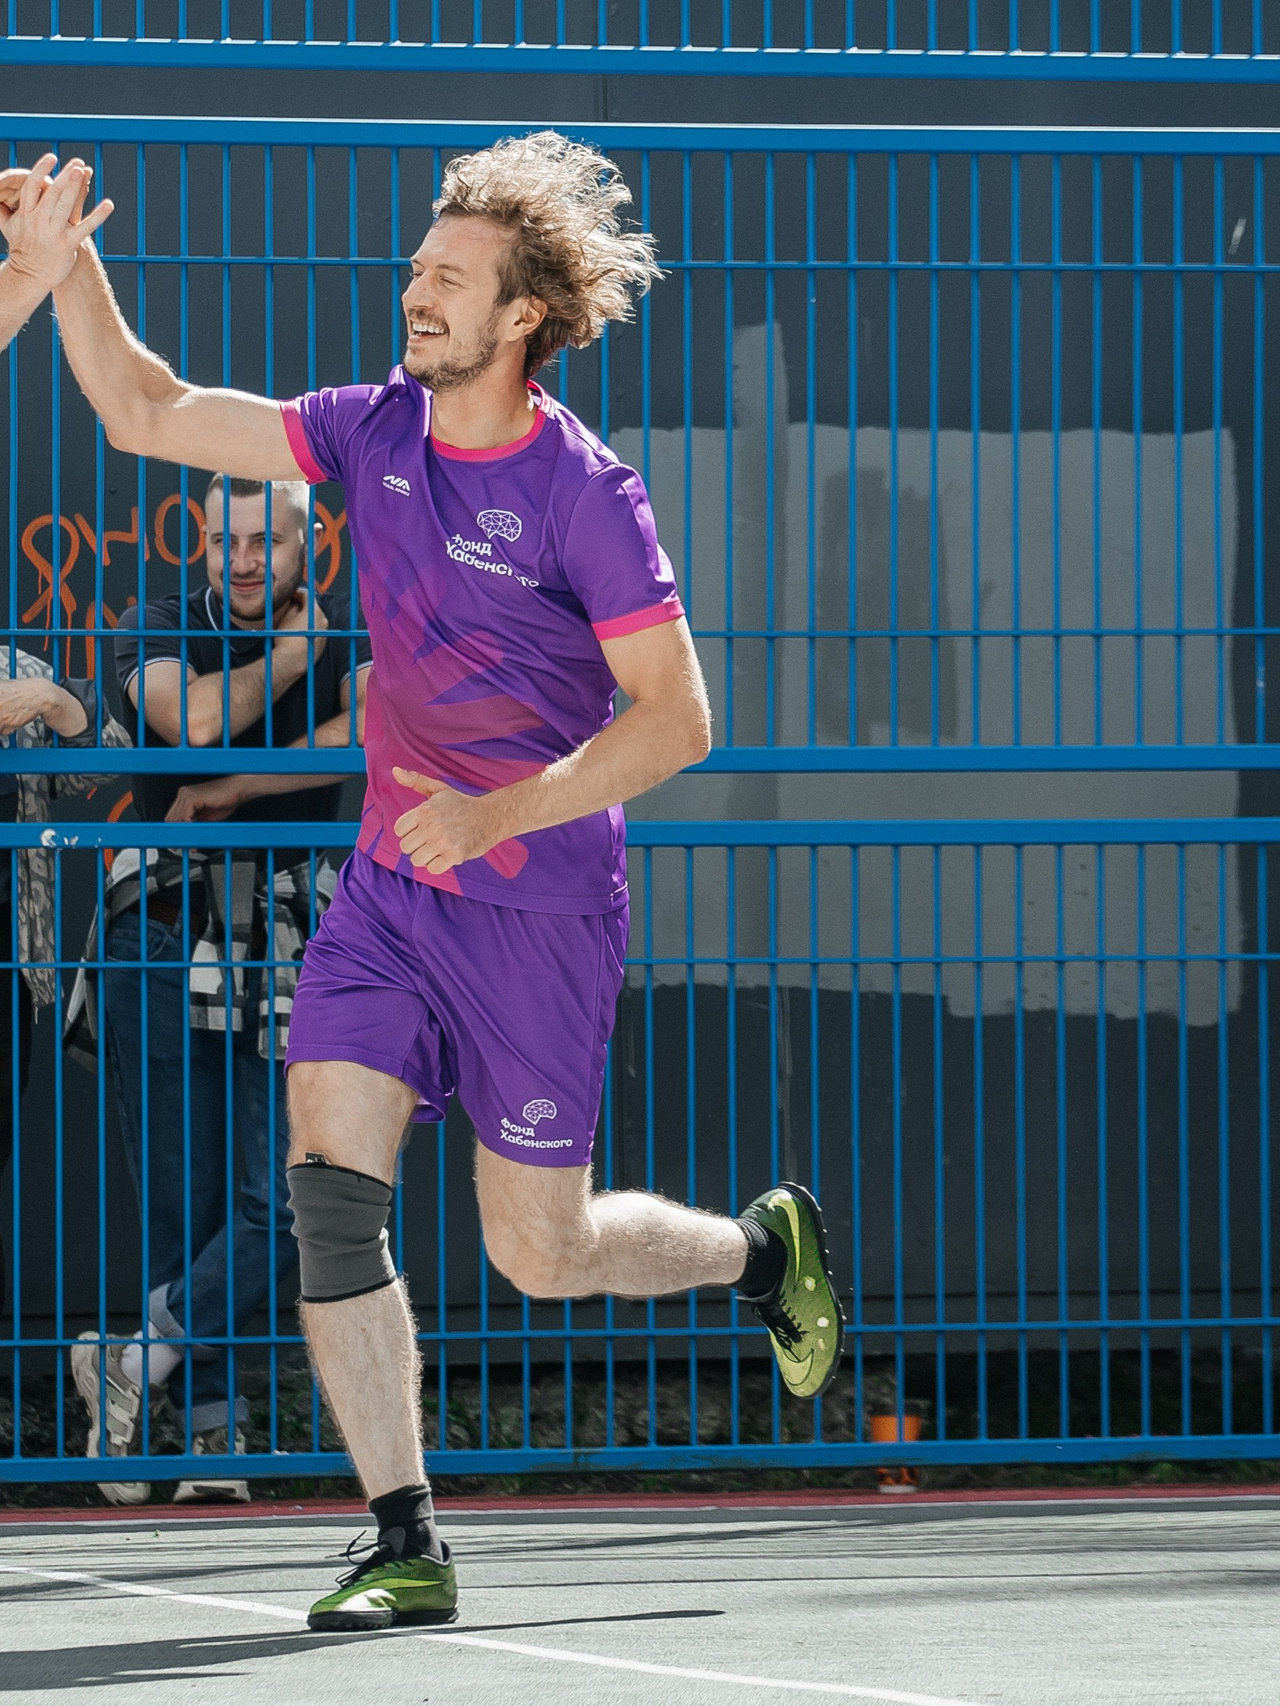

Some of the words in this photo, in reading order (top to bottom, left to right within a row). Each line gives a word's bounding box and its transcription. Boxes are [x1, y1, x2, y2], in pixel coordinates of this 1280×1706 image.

[445, 540, 539, 587] Хабенсго
[500, 1117, 535, 1137] Фонд
[500, 1129, 573, 1149] Хабенского
